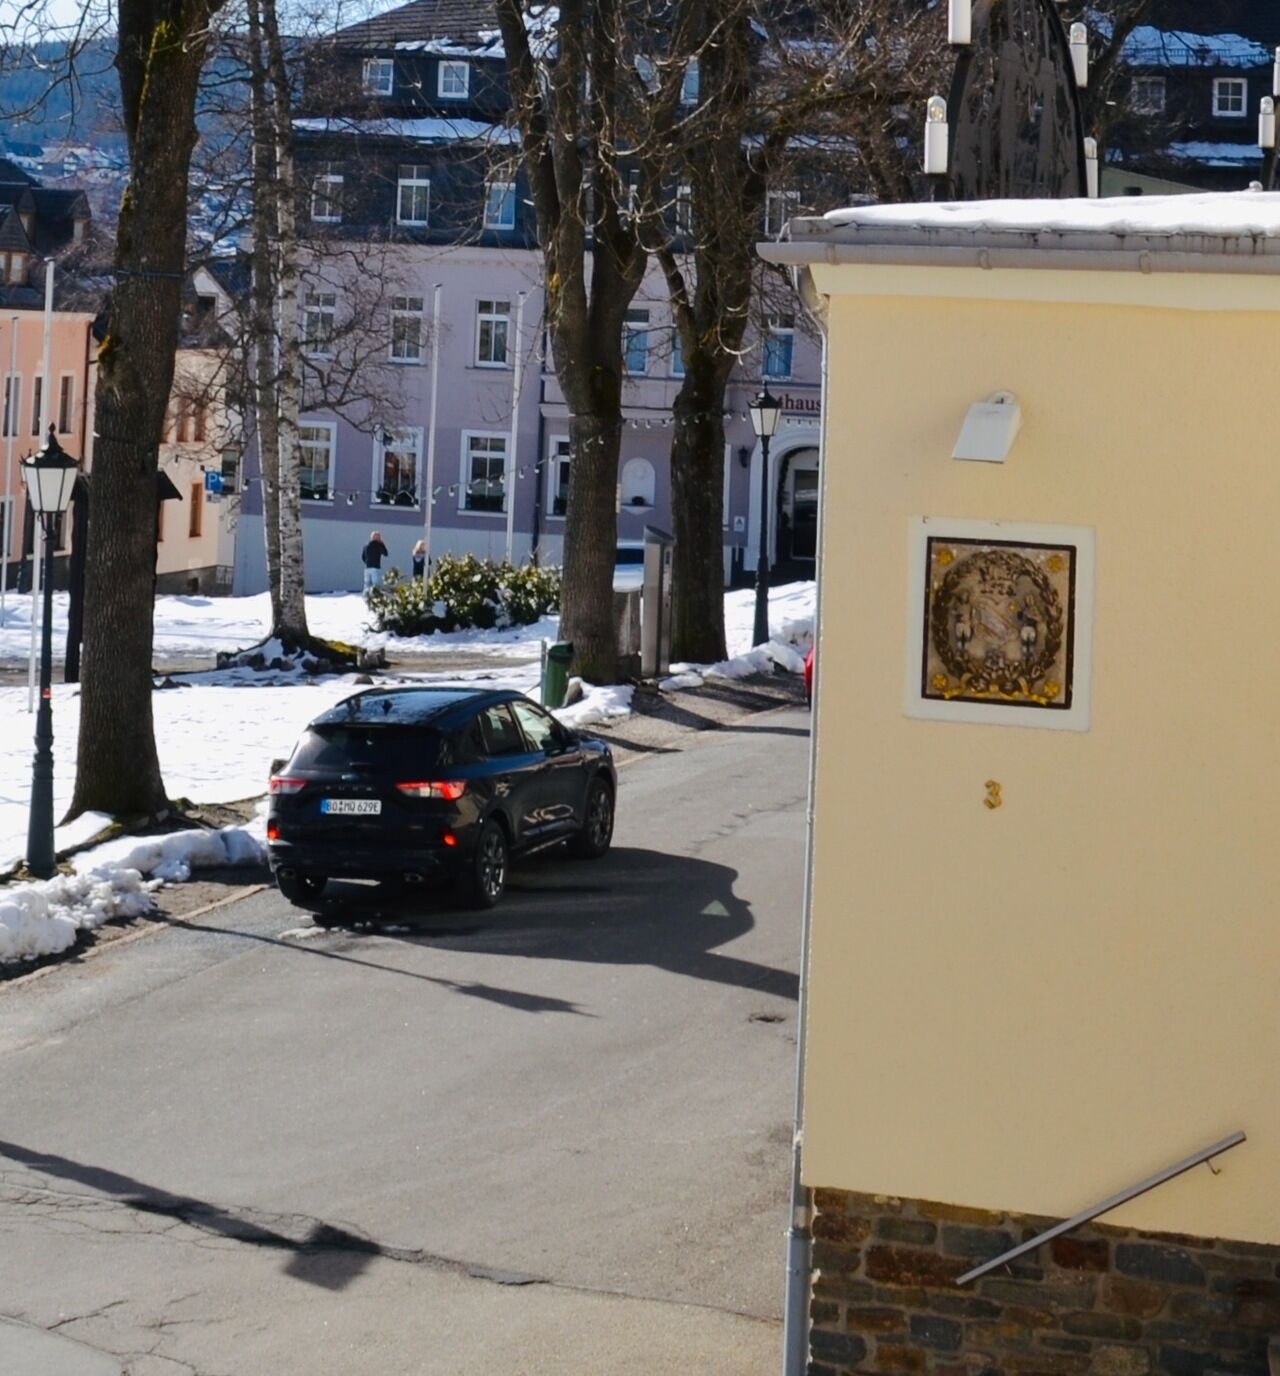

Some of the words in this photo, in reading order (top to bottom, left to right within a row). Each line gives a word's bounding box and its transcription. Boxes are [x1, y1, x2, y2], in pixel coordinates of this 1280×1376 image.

[754, 392, 821, 412] thaus
[208, 473, 218, 489] P
[983, 779, 1002, 810] 3
